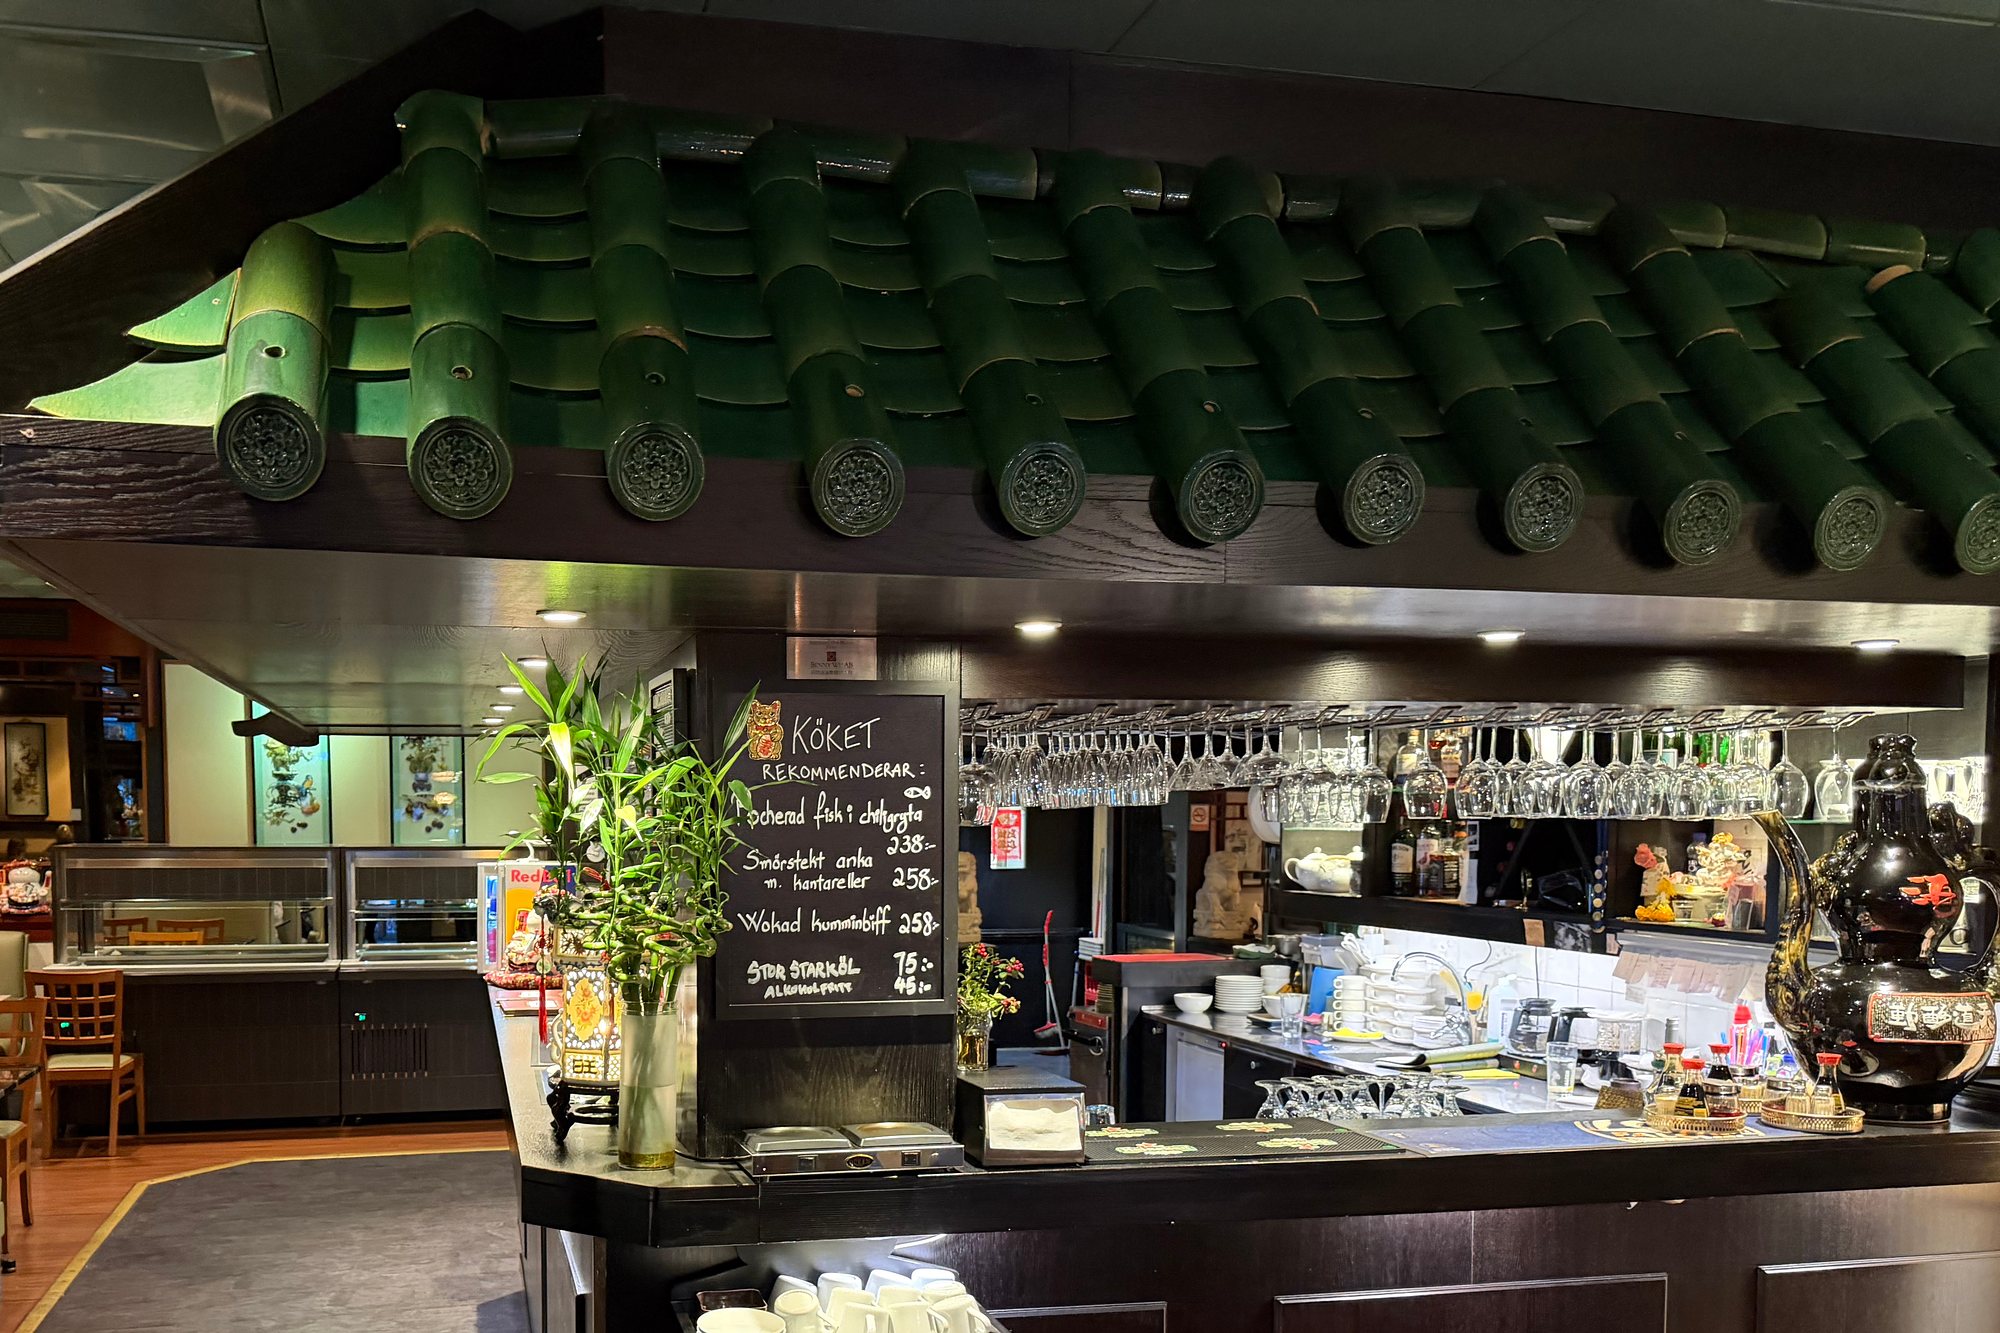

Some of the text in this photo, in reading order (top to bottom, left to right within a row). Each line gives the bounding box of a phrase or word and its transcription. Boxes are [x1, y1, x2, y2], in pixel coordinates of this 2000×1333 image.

[792, 715, 881, 755] KÖKET
[813, 791, 843, 830] fisk
[847, 805, 853, 824] i
[886, 834, 937, 856] 238:-
[742, 847, 873, 871] Smörstekt anka
[511, 869, 539, 883] Red
[764, 867, 940, 892] m. kantareller 258:-
[736, 904, 940, 937] Wokad kumminbiff 258:-
[893, 975, 933, 997] 45:-
